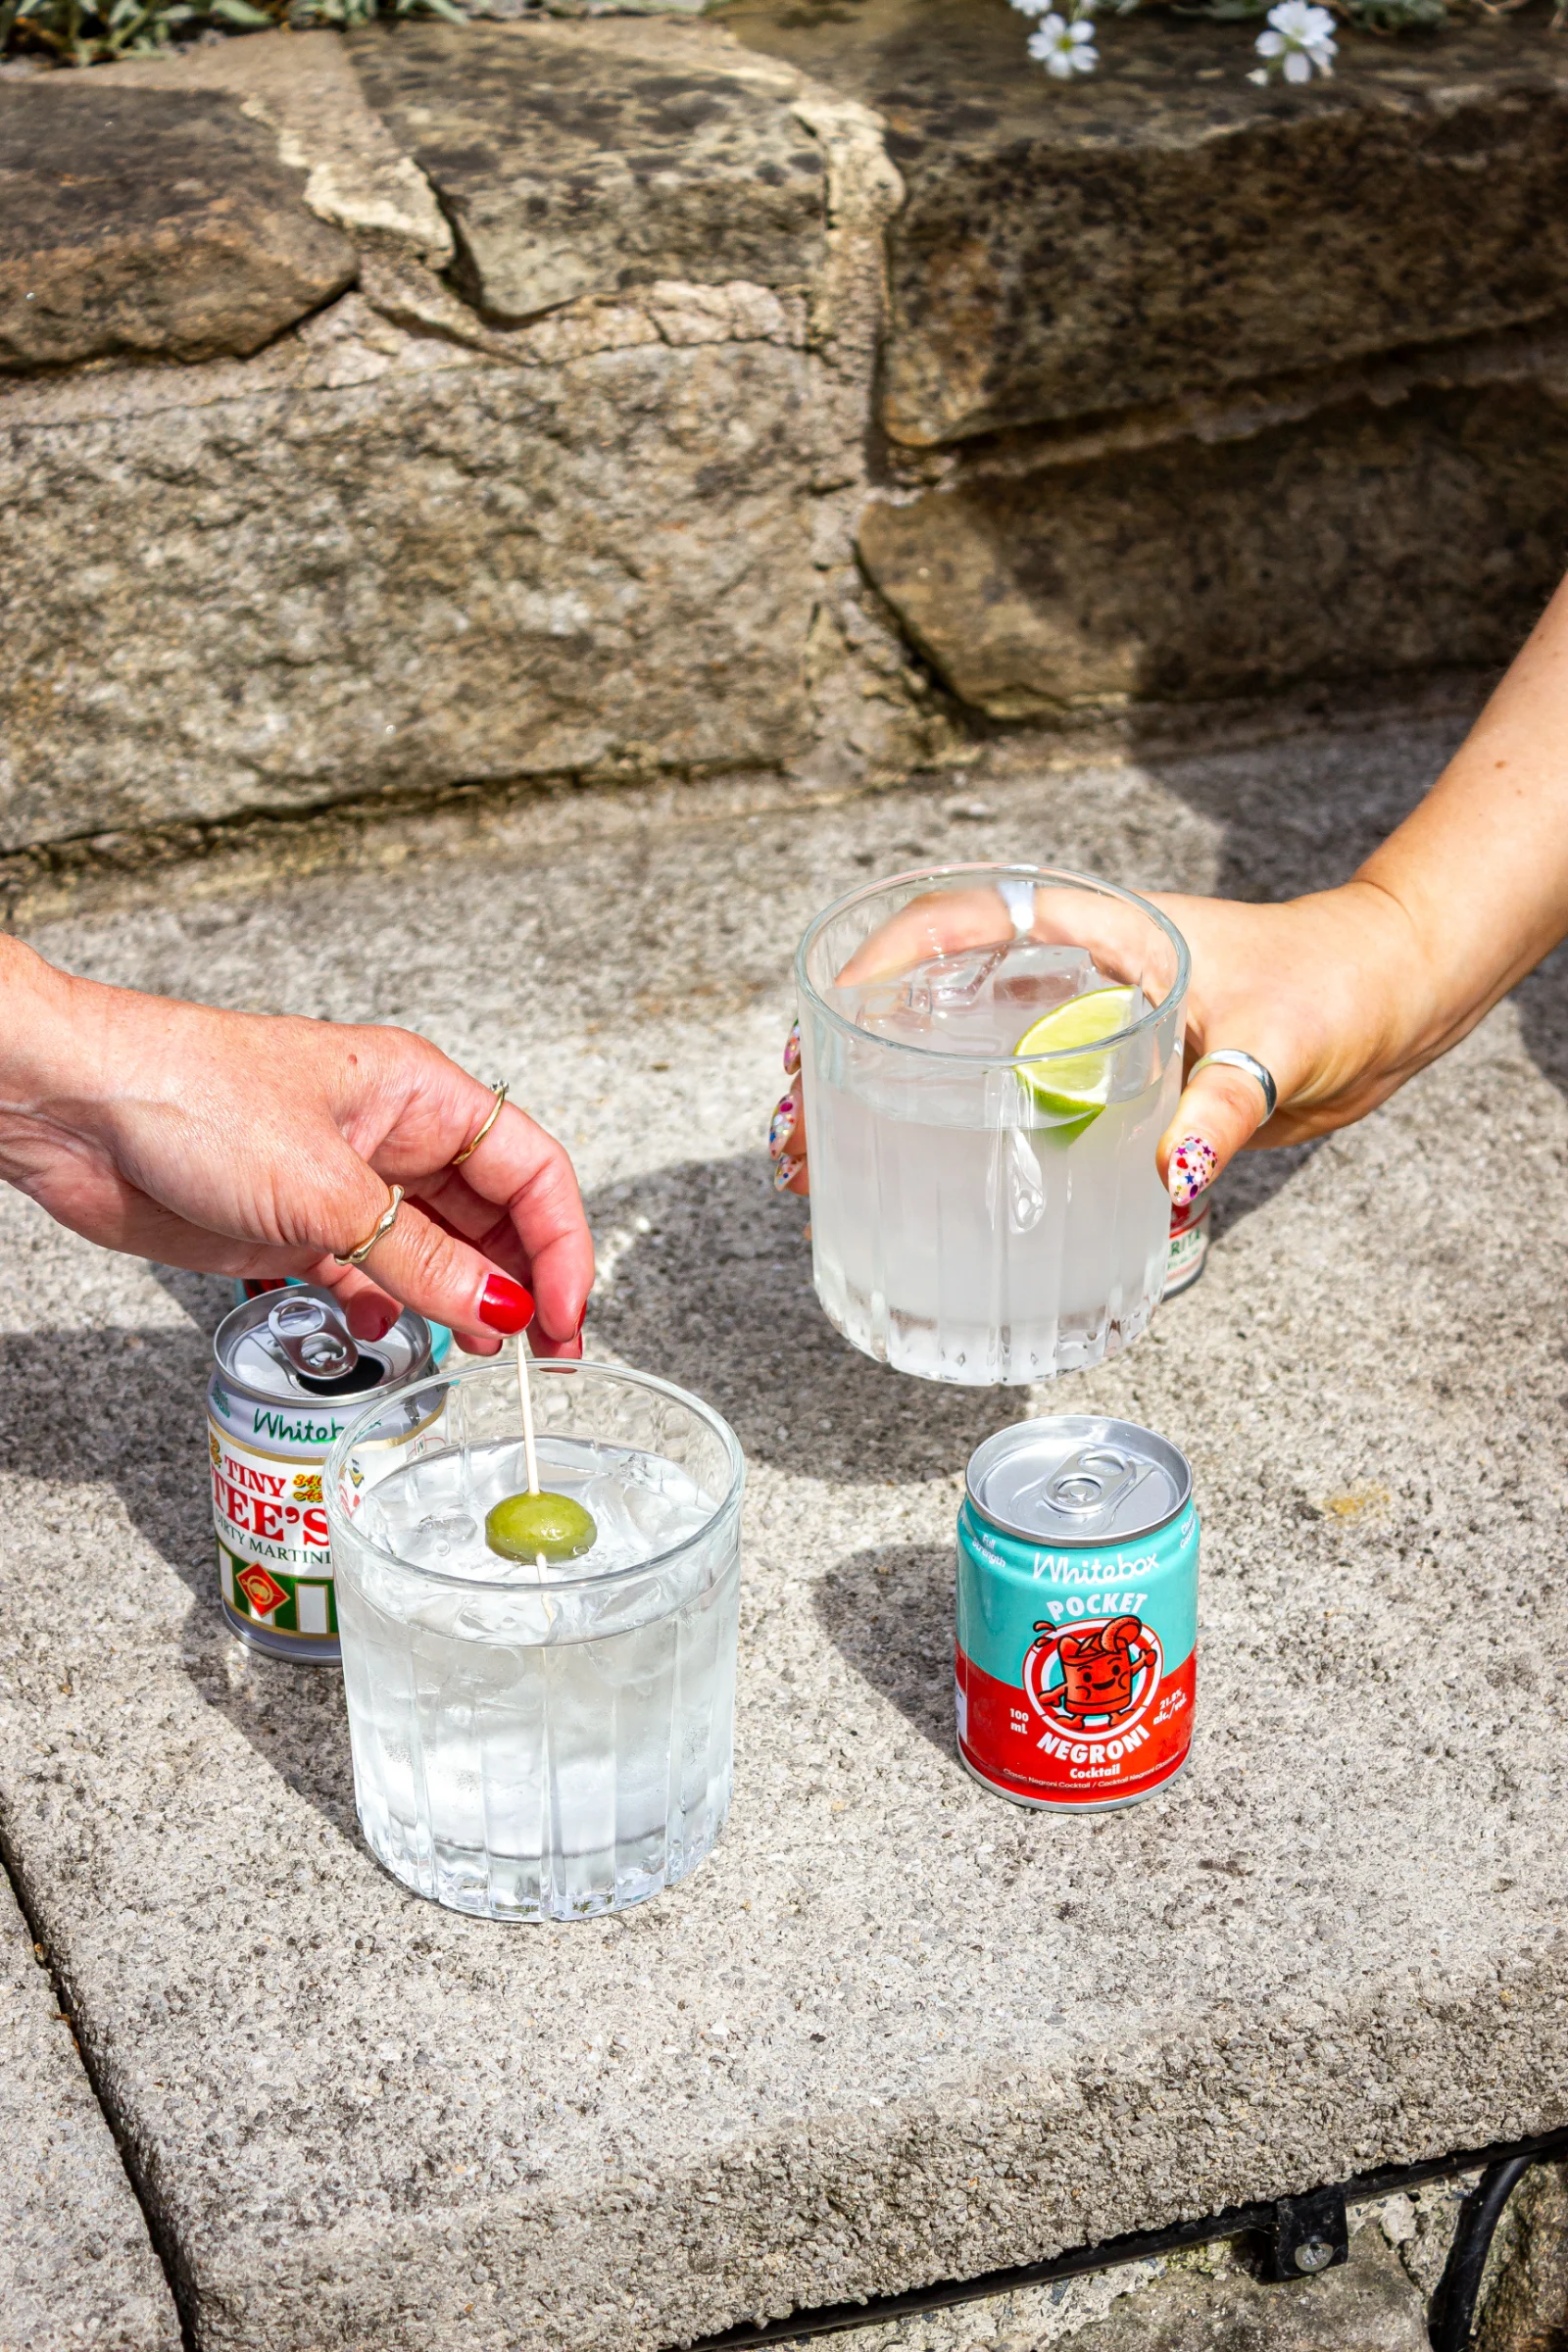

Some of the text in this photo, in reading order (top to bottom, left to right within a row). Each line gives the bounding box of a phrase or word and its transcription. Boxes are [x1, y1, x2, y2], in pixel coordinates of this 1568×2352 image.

[224, 1454, 286, 1498] TINY
[212, 1462, 329, 1546] TEE'S
[215, 1509, 331, 1564] DIRTY MARTINI
[1033, 1552, 1159, 1585] Whitebox
[1046, 1592, 1148, 1622] POCKET
[1009, 1707, 1029, 1723] 100
[1036, 1725, 1151, 1764] NEGRONI
[1003, 1768, 1027, 1782] Classic
[1028, 1777, 1057, 1788] Negroni
[1098, 1777, 1128, 1787] Cocktail
[1069, 1763, 1120, 1779] Cocktail
